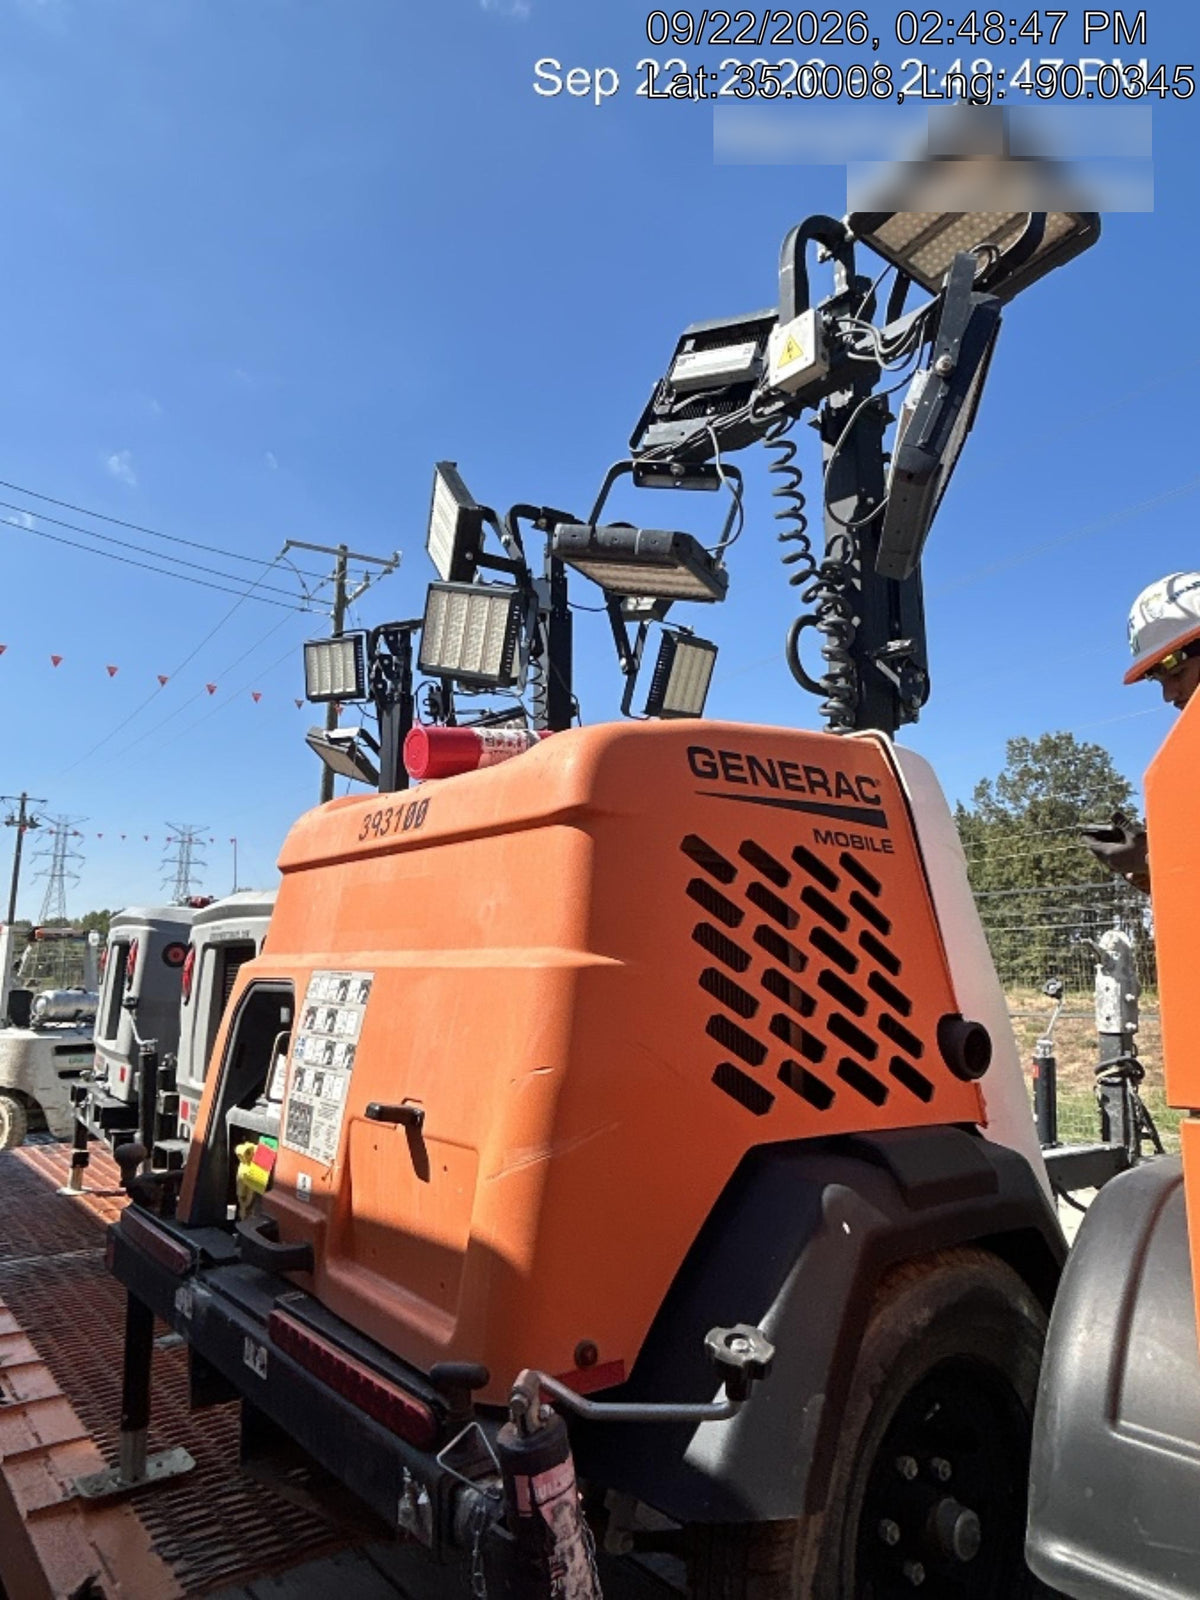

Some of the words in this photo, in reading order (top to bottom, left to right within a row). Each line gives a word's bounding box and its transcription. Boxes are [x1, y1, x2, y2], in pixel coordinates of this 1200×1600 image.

[687, 746, 881, 805] GENERAC
[358, 796, 432, 841] 393100
[813, 828, 895, 854] MOBILE
